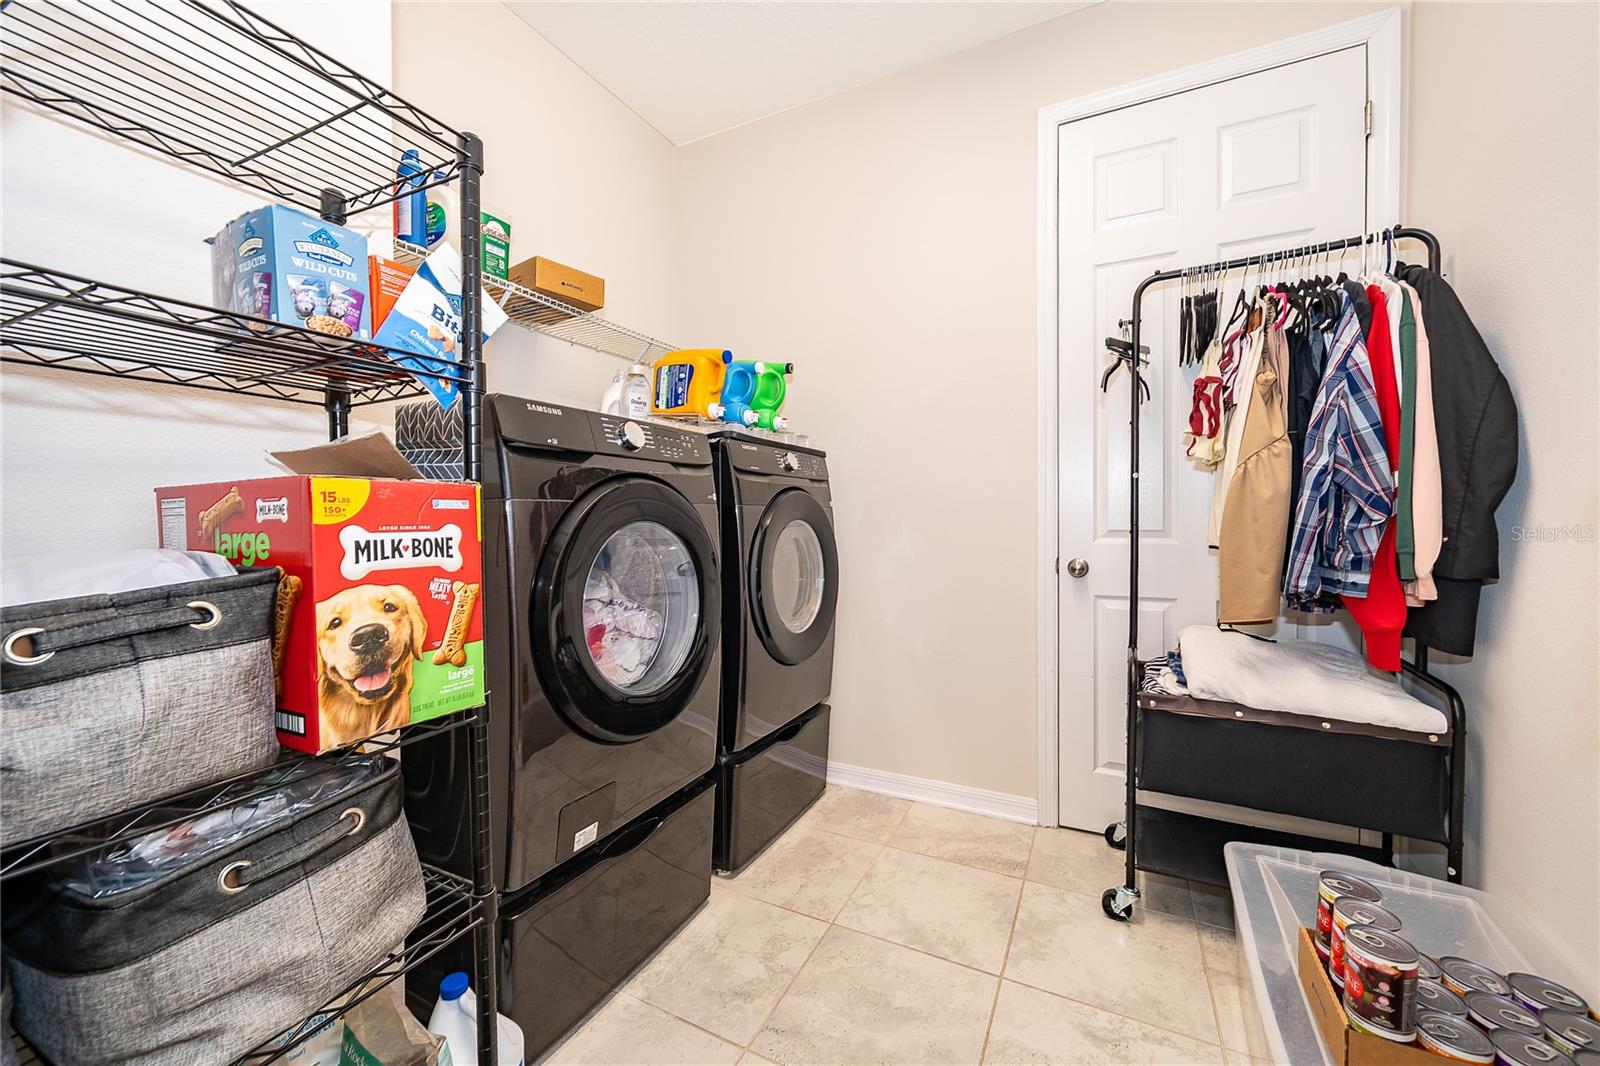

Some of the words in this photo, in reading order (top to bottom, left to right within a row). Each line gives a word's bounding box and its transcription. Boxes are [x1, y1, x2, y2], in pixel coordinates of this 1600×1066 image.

[480, 223, 510, 242] Cascade
[291, 256, 326, 273] WILD
[328, 266, 358, 282] CUTS
[526, 402, 562, 415] SAMSUNG
[320, 491, 336, 503] 15
[323, 506, 346, 514] 150+
[214, 527, 271, 567] large
[429, 581, 452, 593] MEATY
[431, 591, 448, 600] Taste
[448, 666, 474, 680] large
